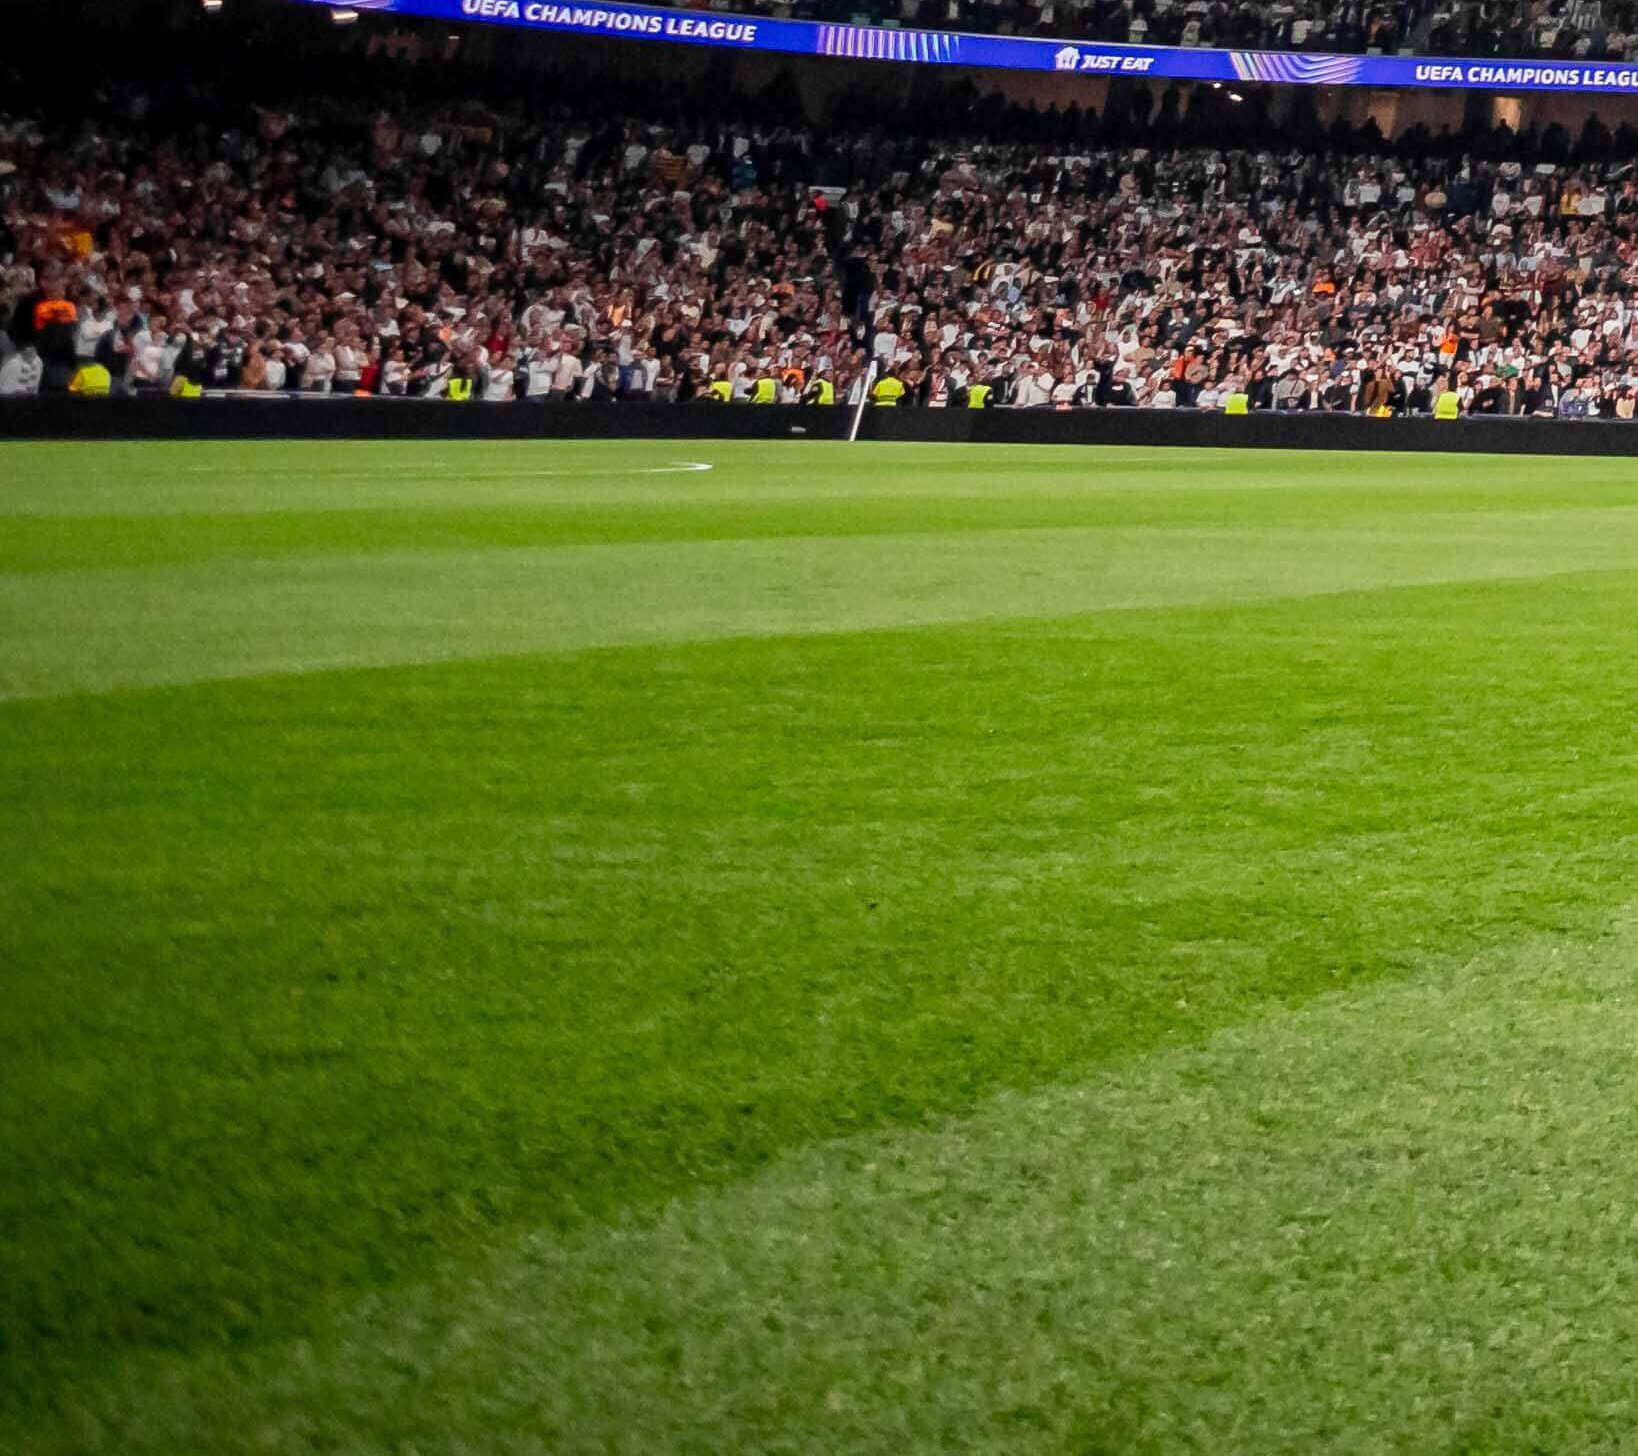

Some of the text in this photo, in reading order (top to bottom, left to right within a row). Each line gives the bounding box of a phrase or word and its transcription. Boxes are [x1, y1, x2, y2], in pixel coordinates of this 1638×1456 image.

[525, 3, 663, 33] CHAMPIONS
[666, 18, 758, 42] LEAGUE
[1081, 55, 1154, 71] JUST EAT
[1416, 65, 1464, 81] UEFA
[1467, 66, 1580, 85] CHAMPIONS
